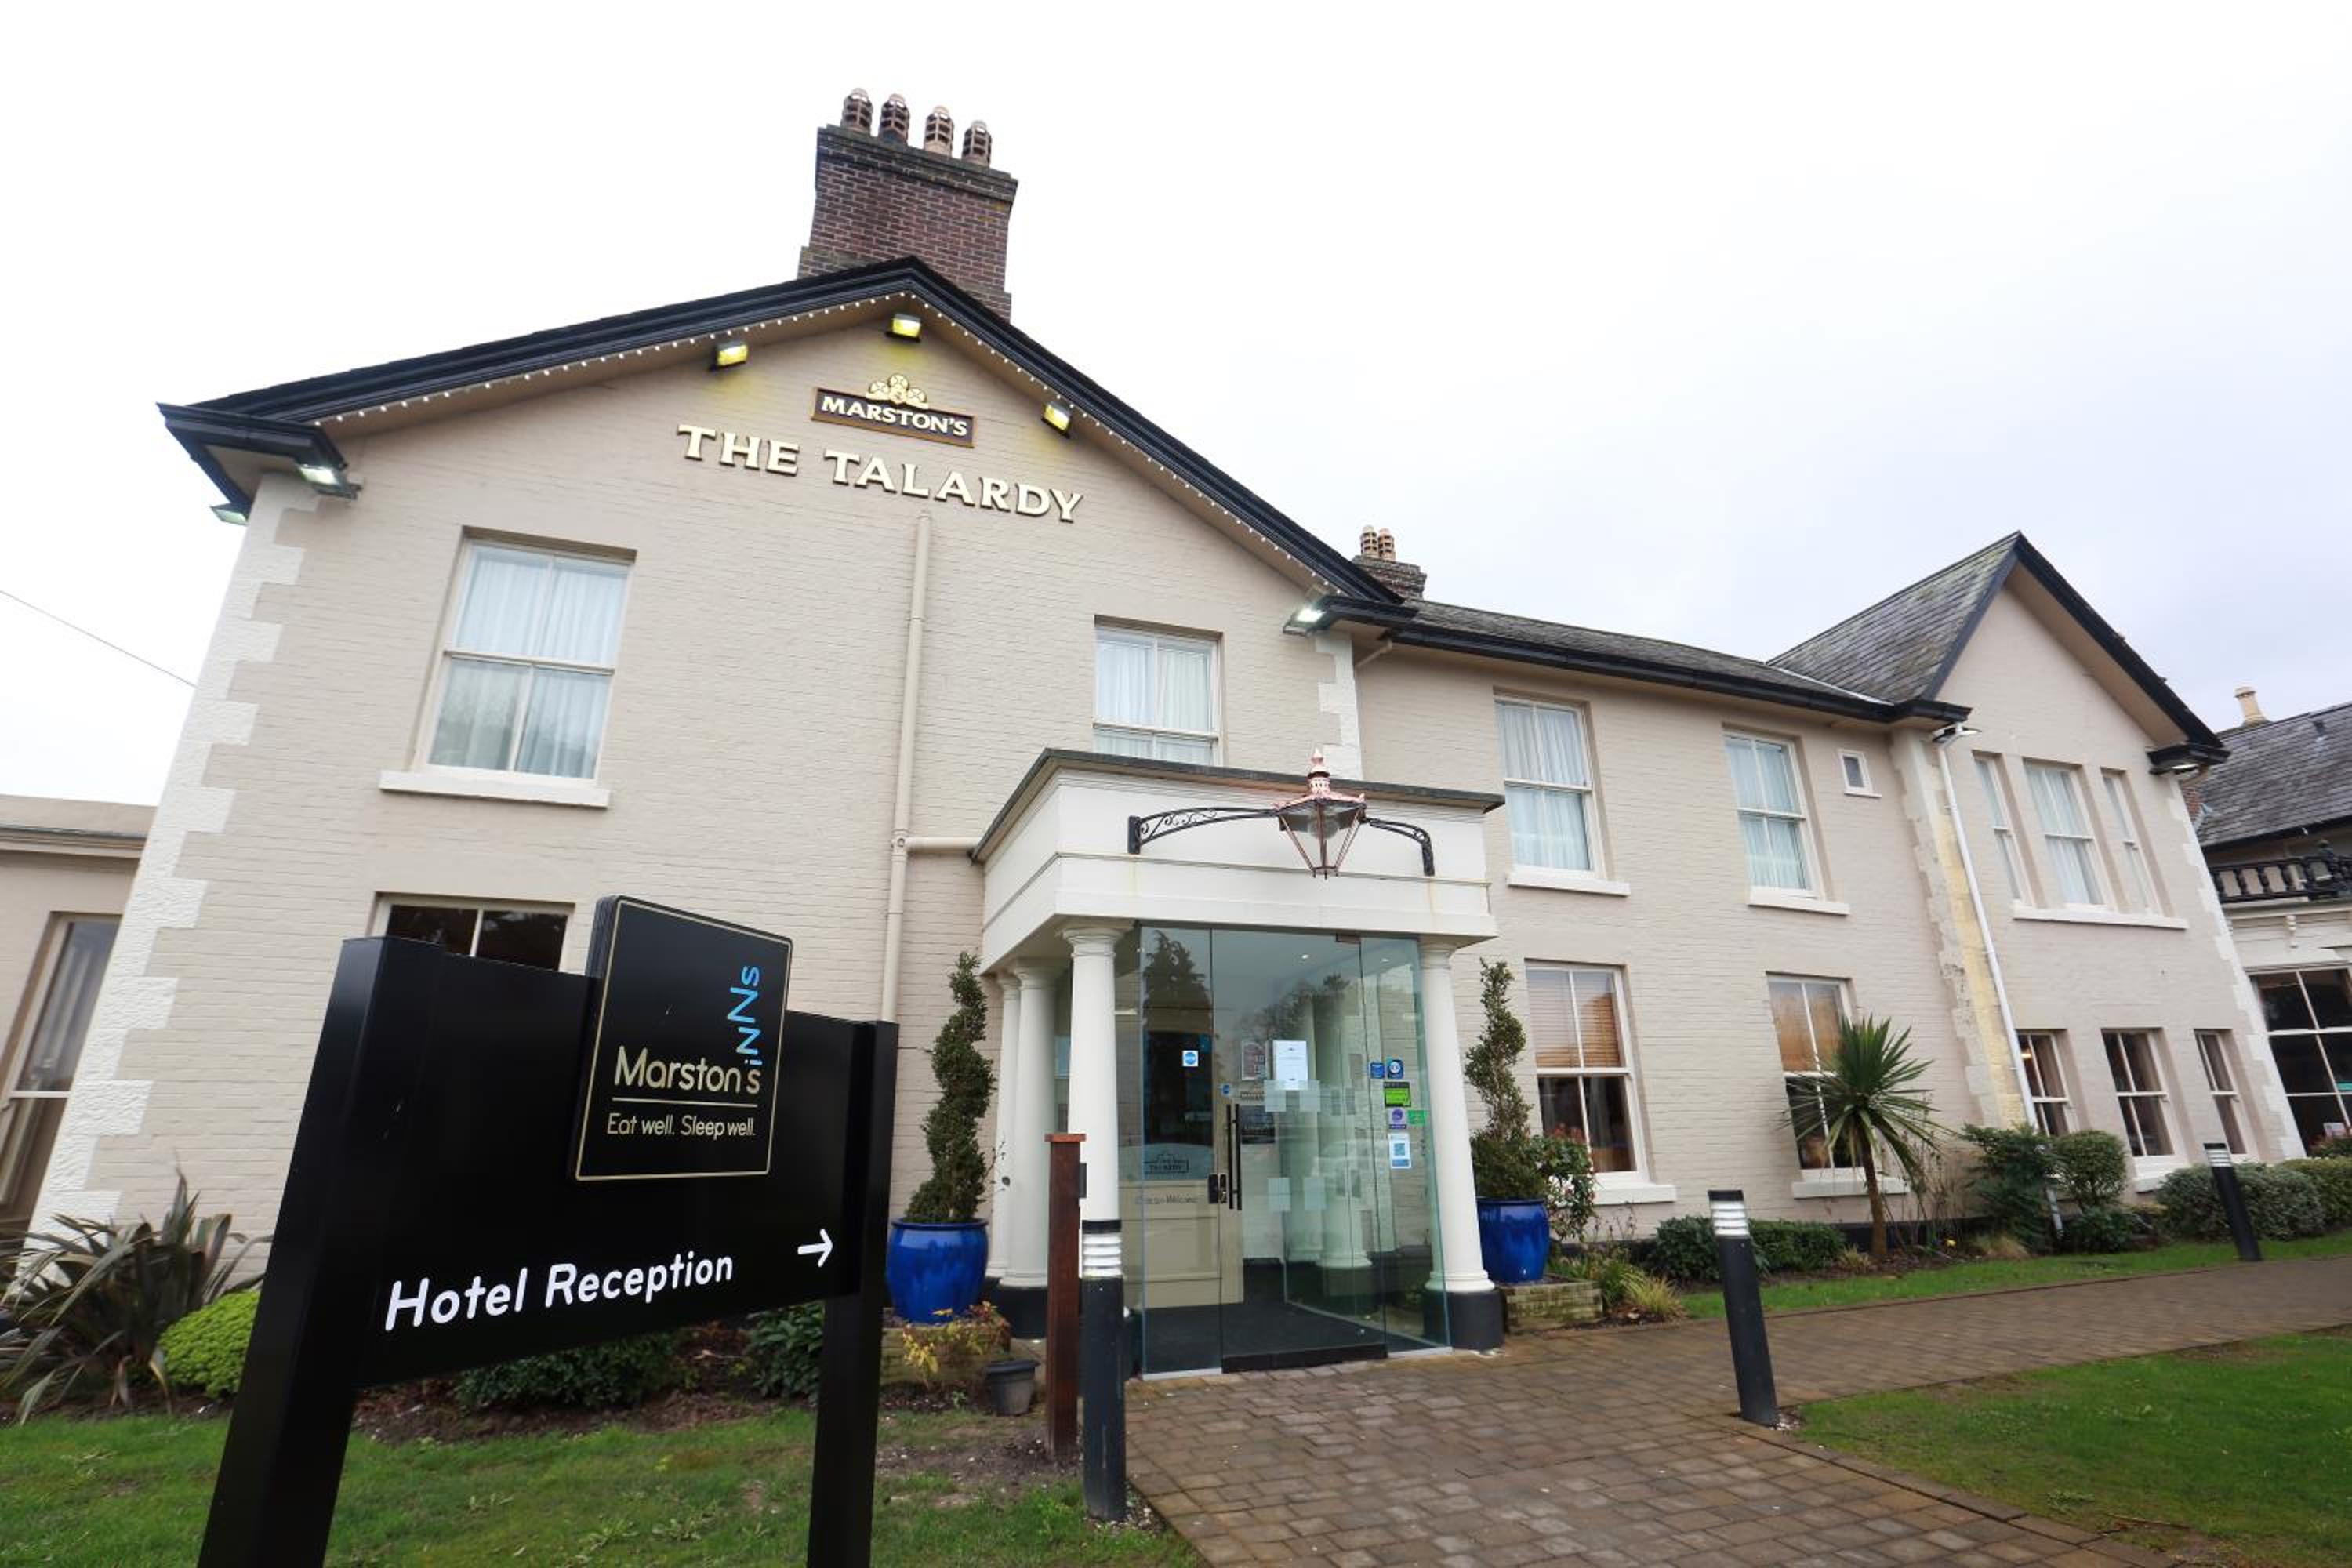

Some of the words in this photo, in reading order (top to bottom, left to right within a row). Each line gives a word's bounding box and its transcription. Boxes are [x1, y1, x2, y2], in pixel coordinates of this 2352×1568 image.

[821, 396, 967, 437] MARSTON'S
[677, 424, 800, 476] THE
[825, 448, 1083, 522] TALARDY
[607, 1112, 637, 1135] Eat
[641, 1114, 675, 1136] well.
[681, 1115, 725, 1141] Sleep
[727, 1118, 756, 1136] well.
[385, 1268, 528, 1331] Hotel
[545, 1250, 734, 1308] Reception
